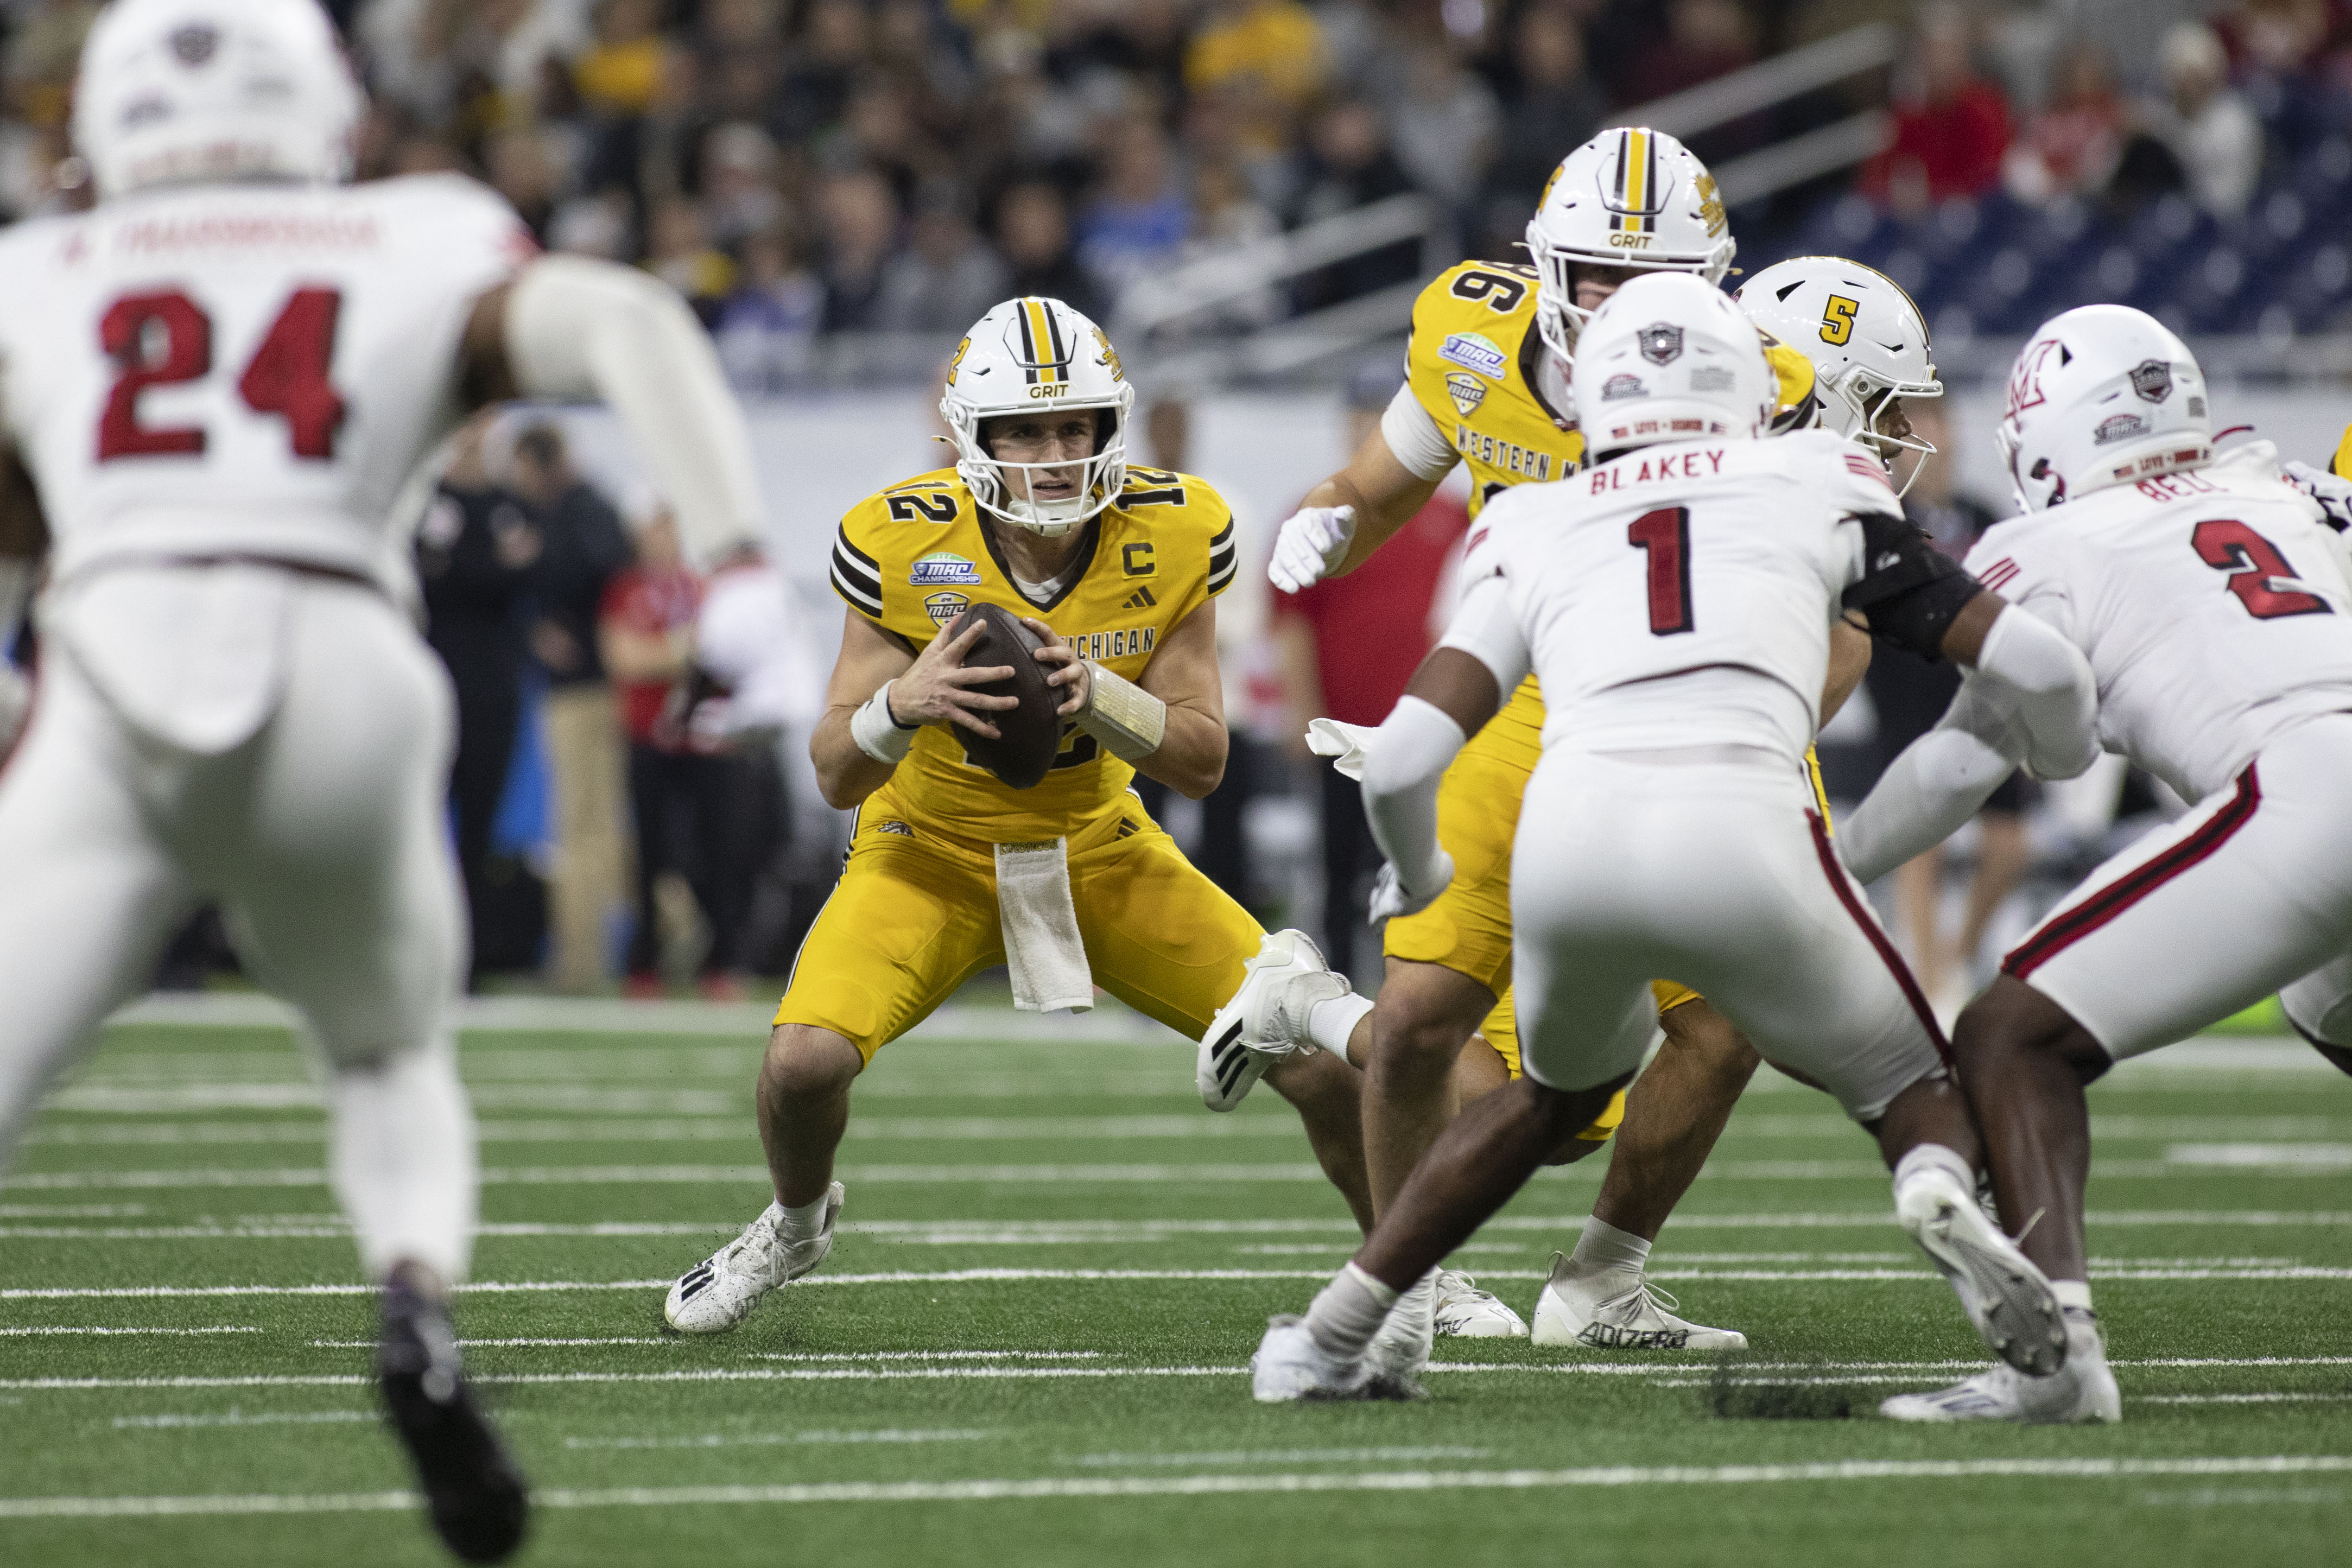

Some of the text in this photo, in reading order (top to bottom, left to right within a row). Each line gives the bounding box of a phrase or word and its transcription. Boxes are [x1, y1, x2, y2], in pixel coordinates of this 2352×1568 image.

[1610, 233, 1652, 249] GRIT
[1818, 294, 1860, 347] 5
[97, 285, 347, 460] 24
[1455, 342, 1502, 367] MAC
[1030, 384, 1069, 398] GRIT
[1456, 423, 1556, 482] WESTERN
[1590, 449, 1725, 496] BLAKEY
[879, 480, 959, 524] 12
[927, 564, 969, 575] MAC
[1122, 542, 1155, 576] C
[1627, 505, 1695, 637] 1
[2191, 519, 2335, 620] 2
[928, 605, 966, 616] MAC
[1060, 627, 1155, 661] CHIGAN
